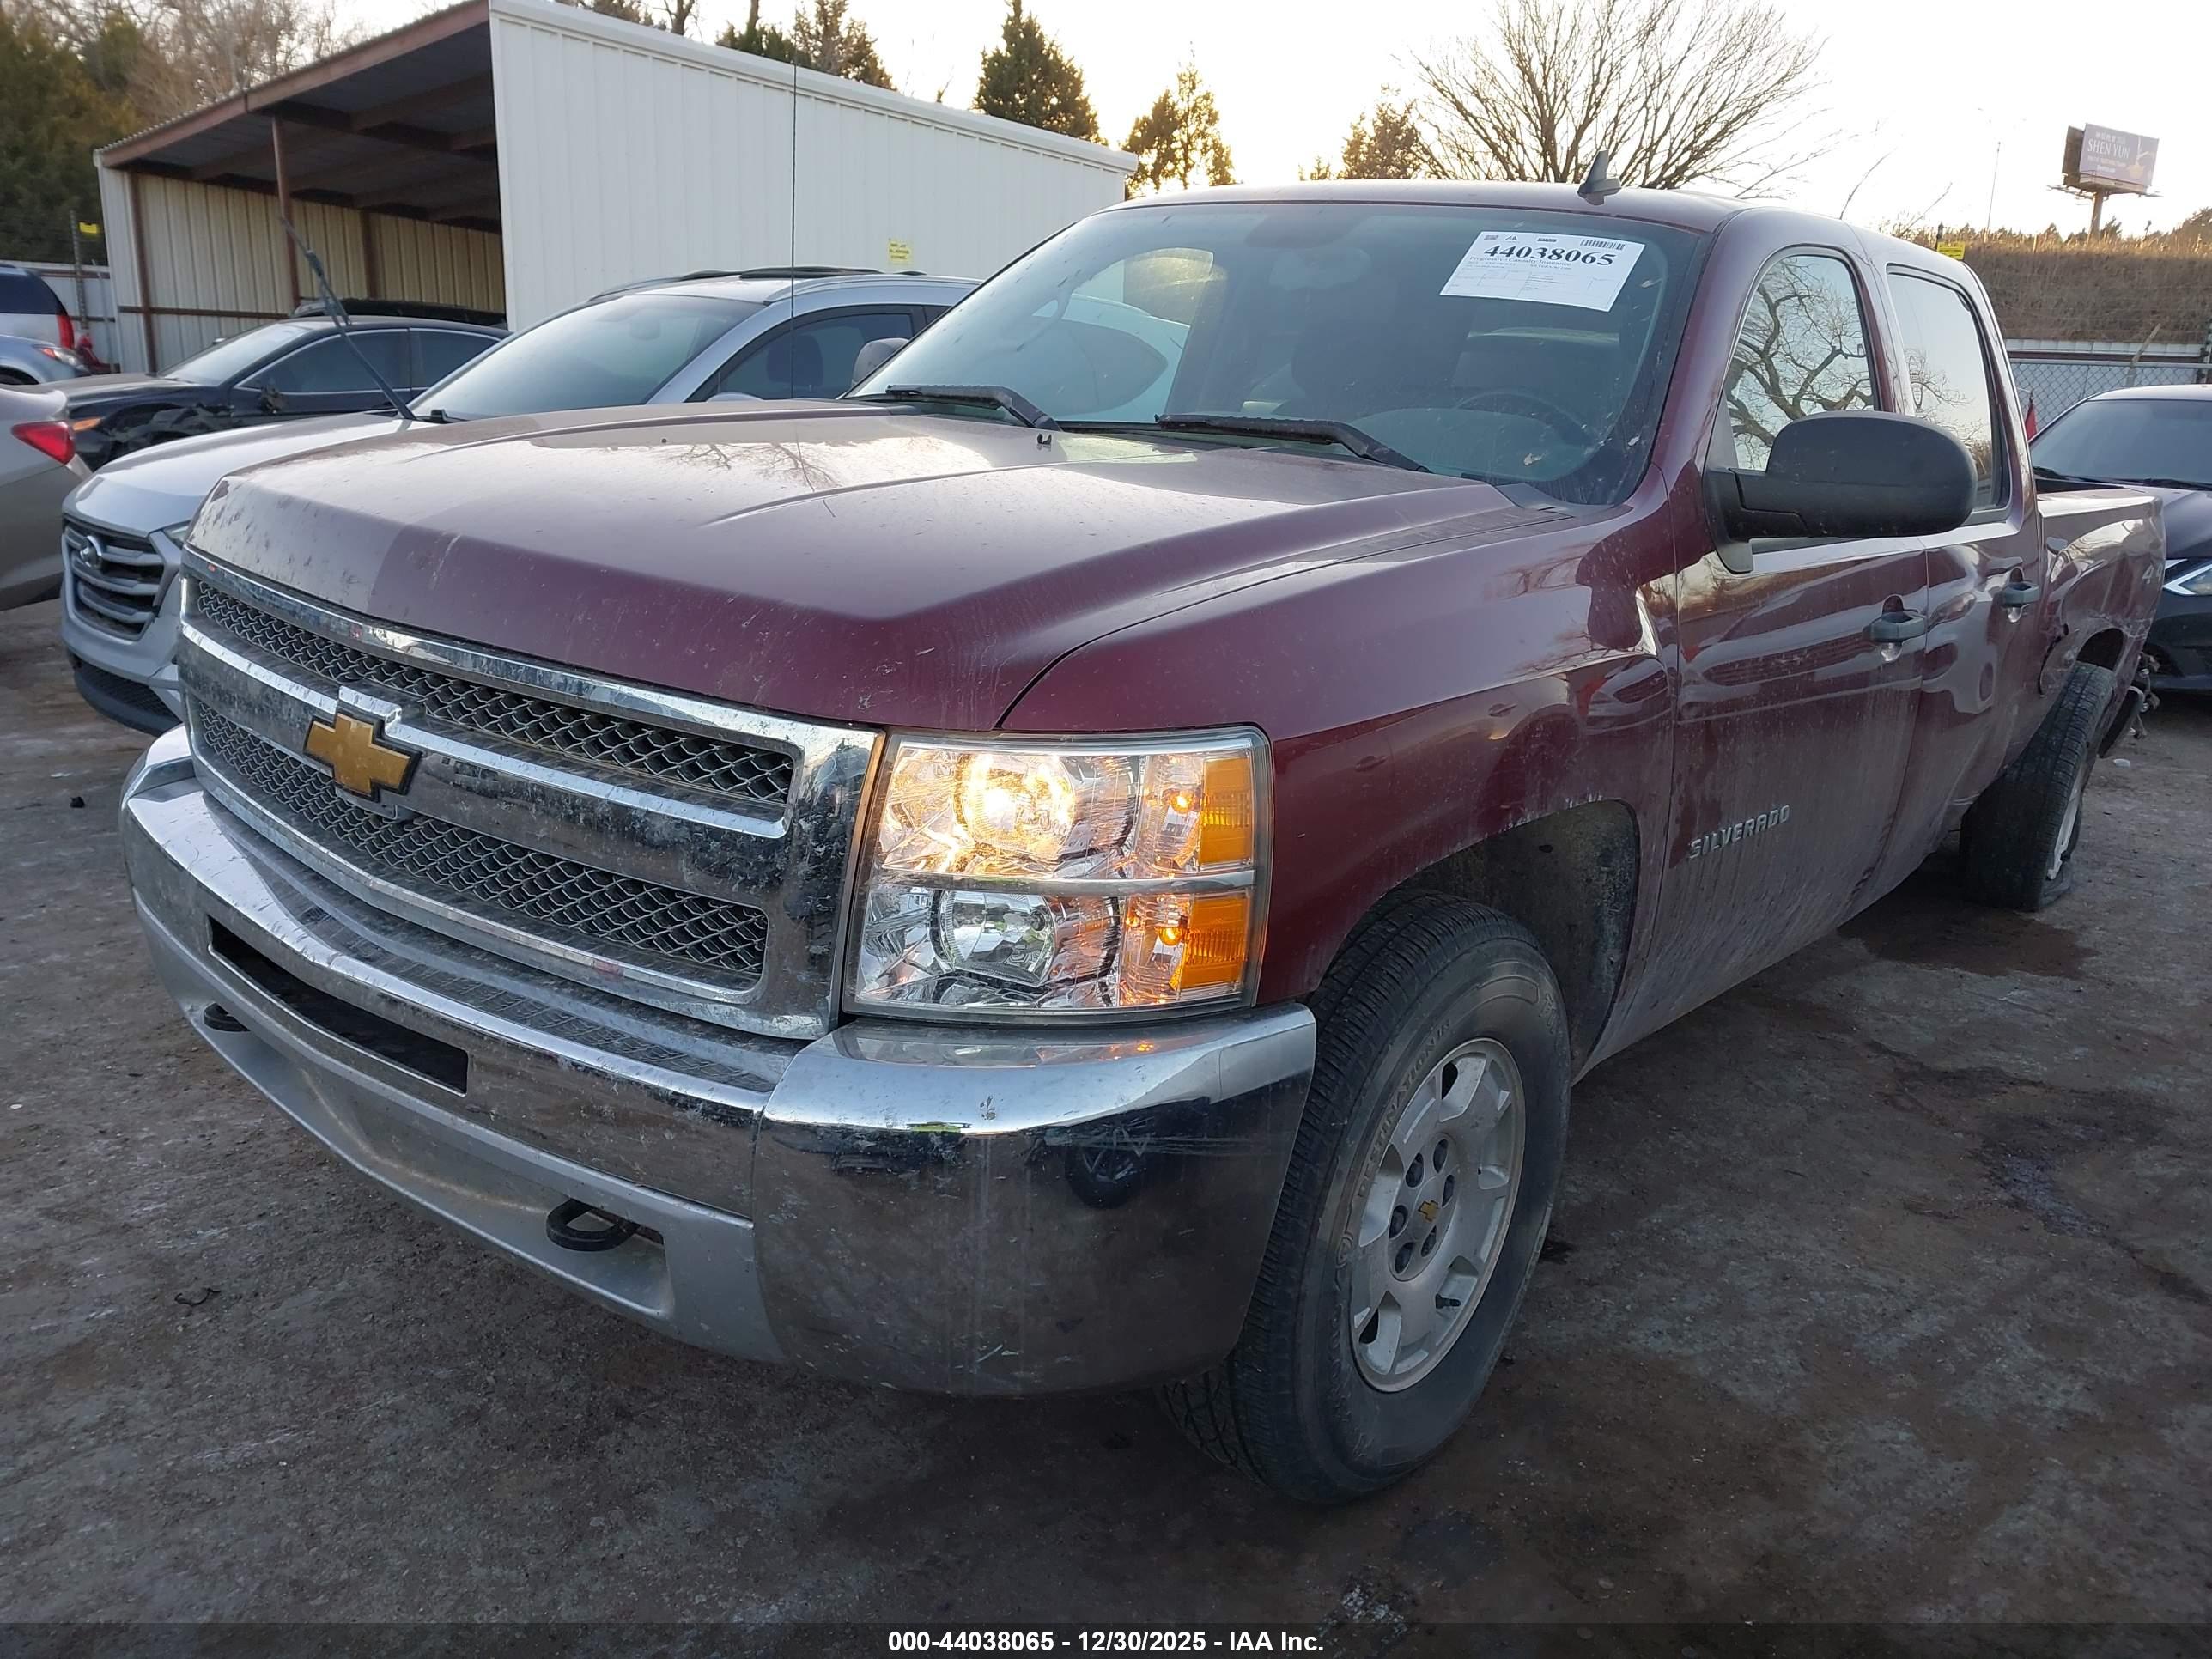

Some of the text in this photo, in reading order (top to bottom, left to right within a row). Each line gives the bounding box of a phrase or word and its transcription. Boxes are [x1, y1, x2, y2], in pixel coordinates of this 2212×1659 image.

[2087, 138, 2130, 159] SHEN YUN
[1484, 245, 1617, 266] 44038065
[1689, 805, 1790, 859] SILVERADO
